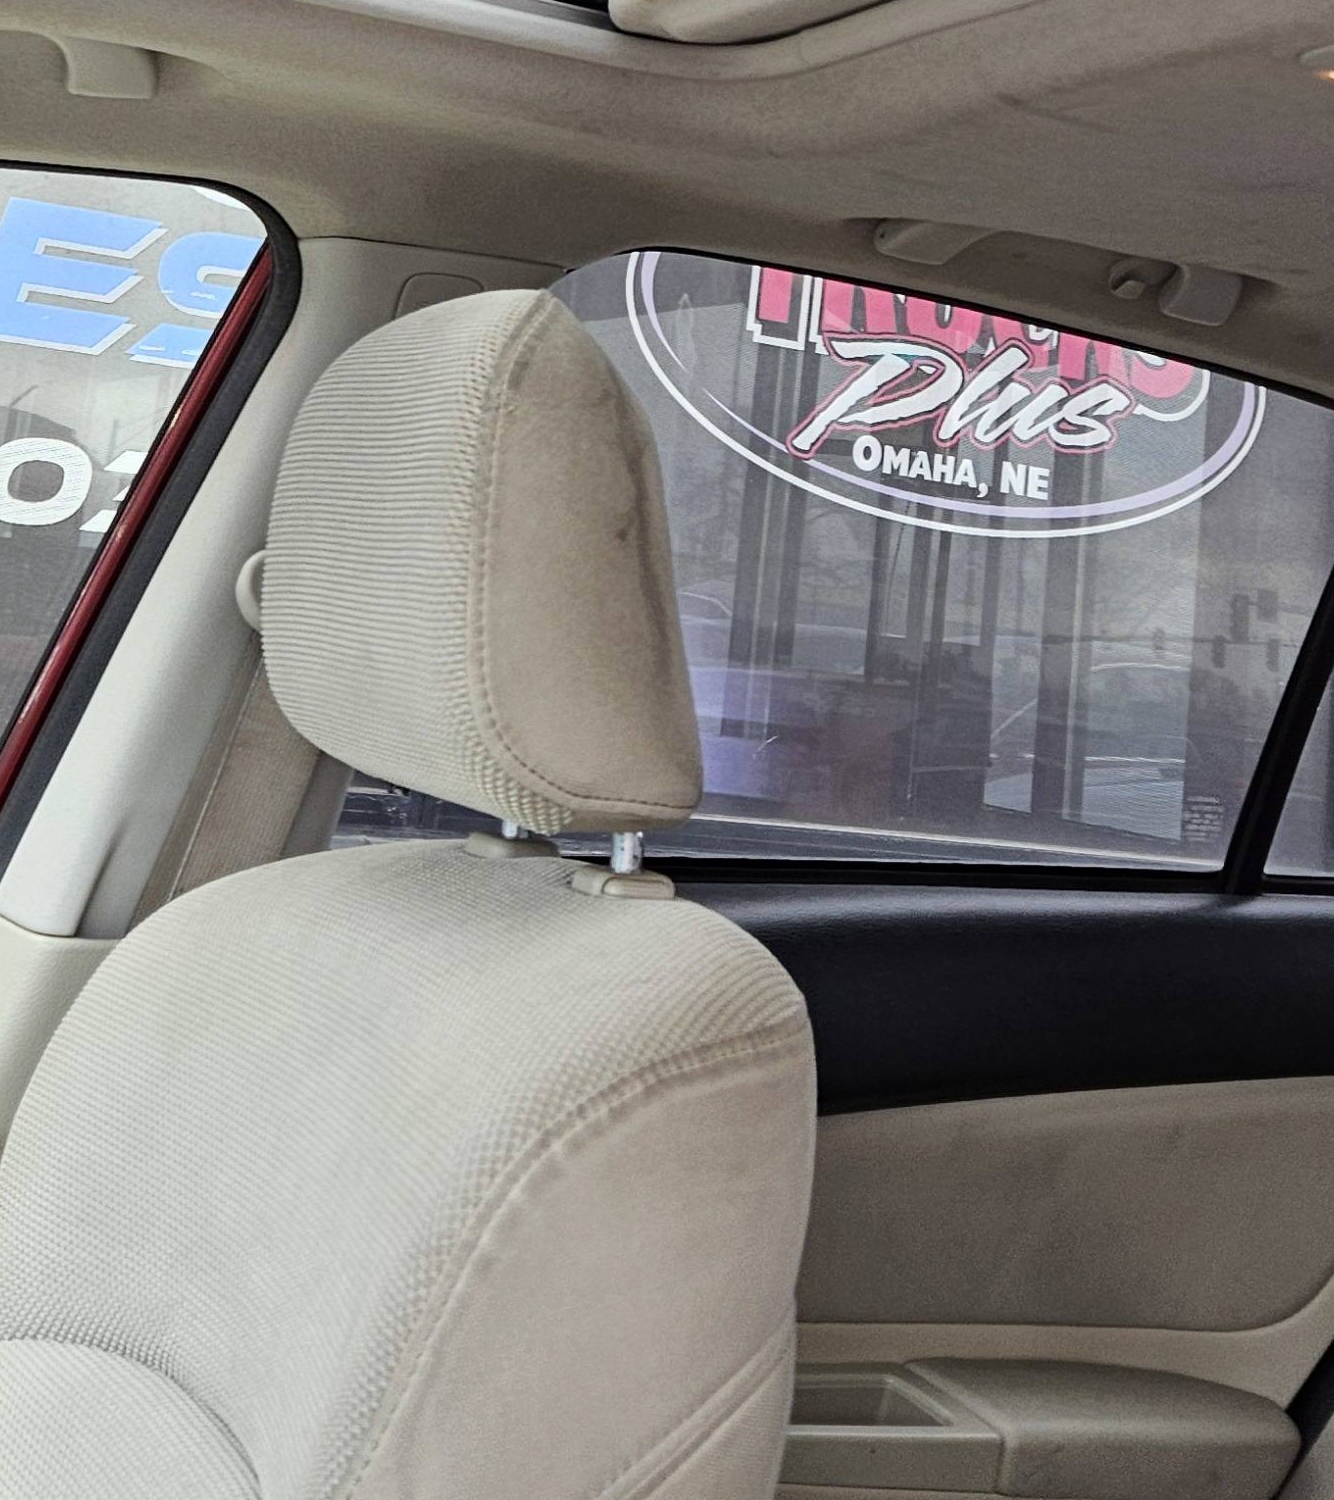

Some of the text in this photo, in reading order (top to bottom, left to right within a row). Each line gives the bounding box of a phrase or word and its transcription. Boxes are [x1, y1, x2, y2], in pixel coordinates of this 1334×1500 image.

[785, 338, 1135, 460] Plus
[852, 434, 1051, 501] OMAHA, NE
